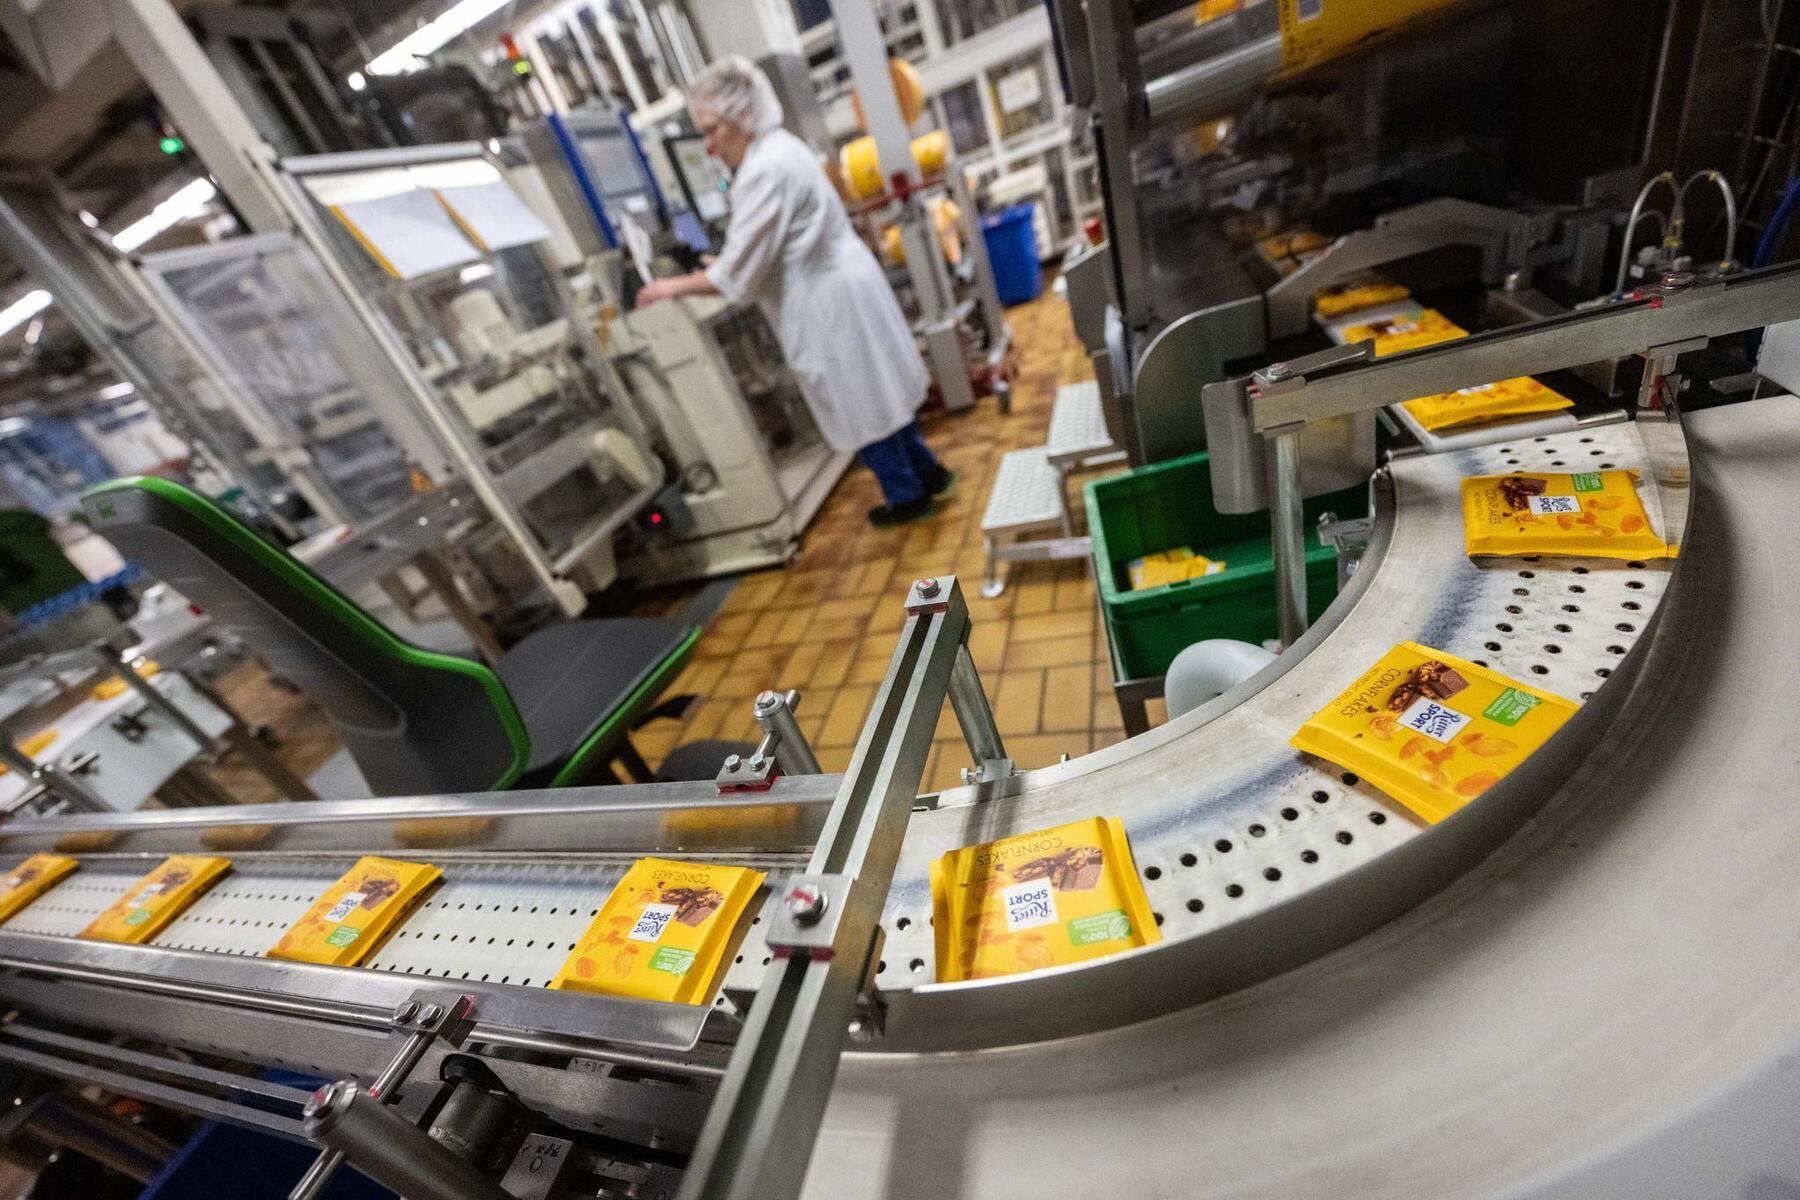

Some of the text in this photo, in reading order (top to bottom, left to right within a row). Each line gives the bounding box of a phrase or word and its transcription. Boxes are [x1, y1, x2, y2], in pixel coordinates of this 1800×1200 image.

[1340, 668, 1401, 718] CORNFLAKES
[1411, 704, 1441, 729] SPORT
[1426, 709, 1463, 737] Ritter
[976, 837, 1063, 867] CORNFLAKES
[1009, 889, 1048, 905] SPORT
[642, 911, 671, 922] SPORT
[1011, 901, 1052, 922] Ritter
[634, 921, 664, 938] Ritter
